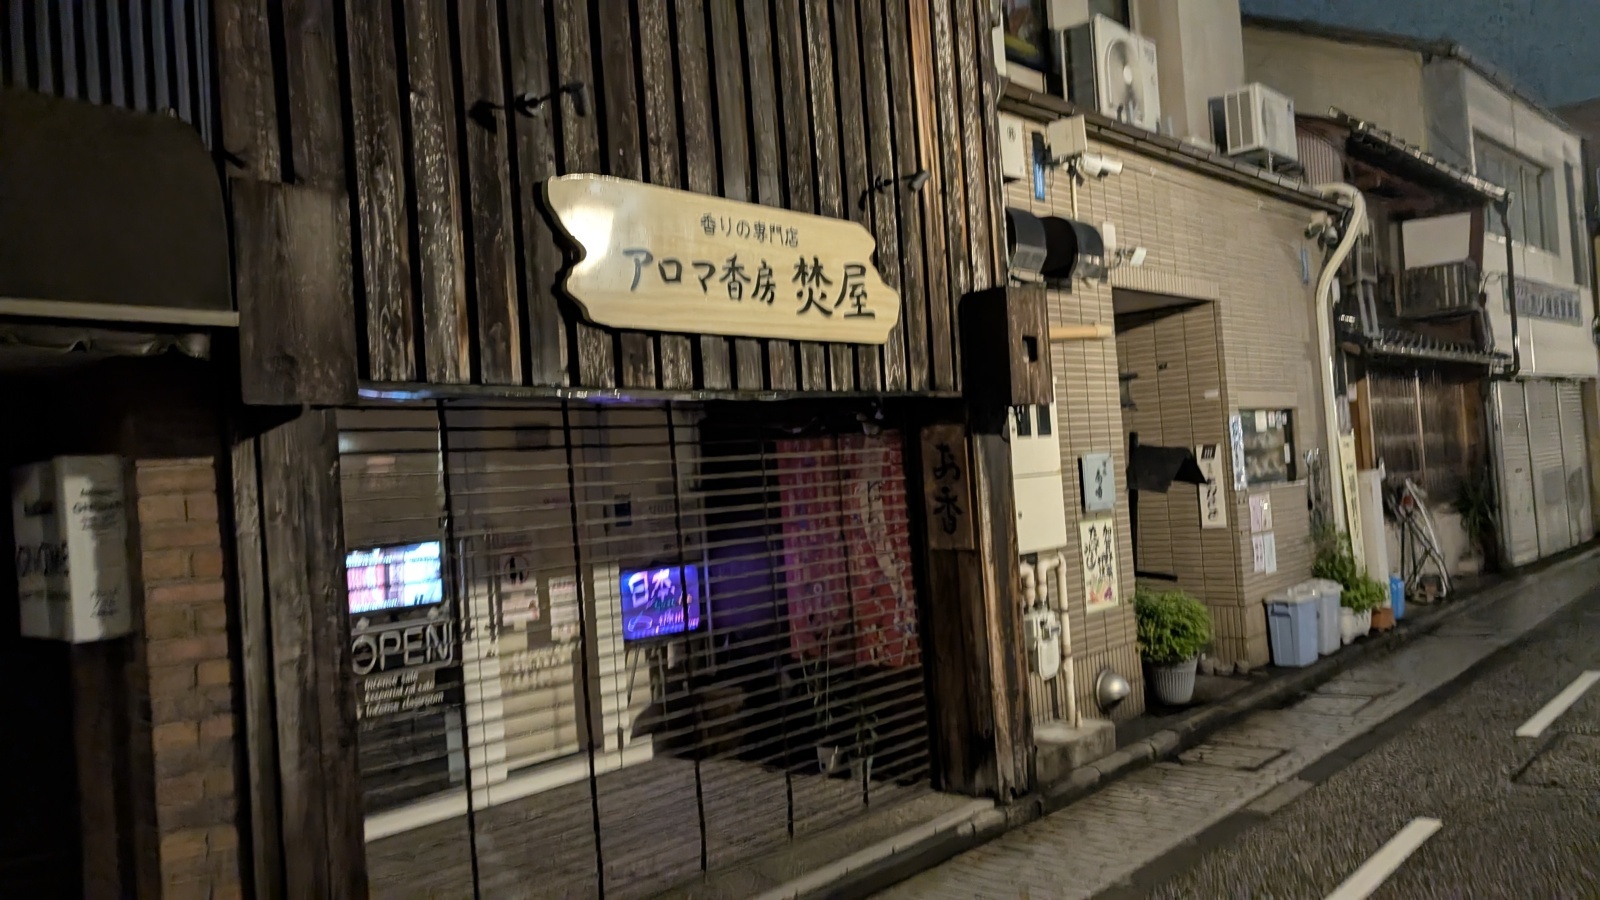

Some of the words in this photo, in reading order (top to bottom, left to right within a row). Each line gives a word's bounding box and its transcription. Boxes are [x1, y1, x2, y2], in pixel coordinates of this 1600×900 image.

[622, 248, 777, 305] アロマ香房
[792, 255, 876, 319] 焚屋
[352, 624, 449, 675] OPEN
